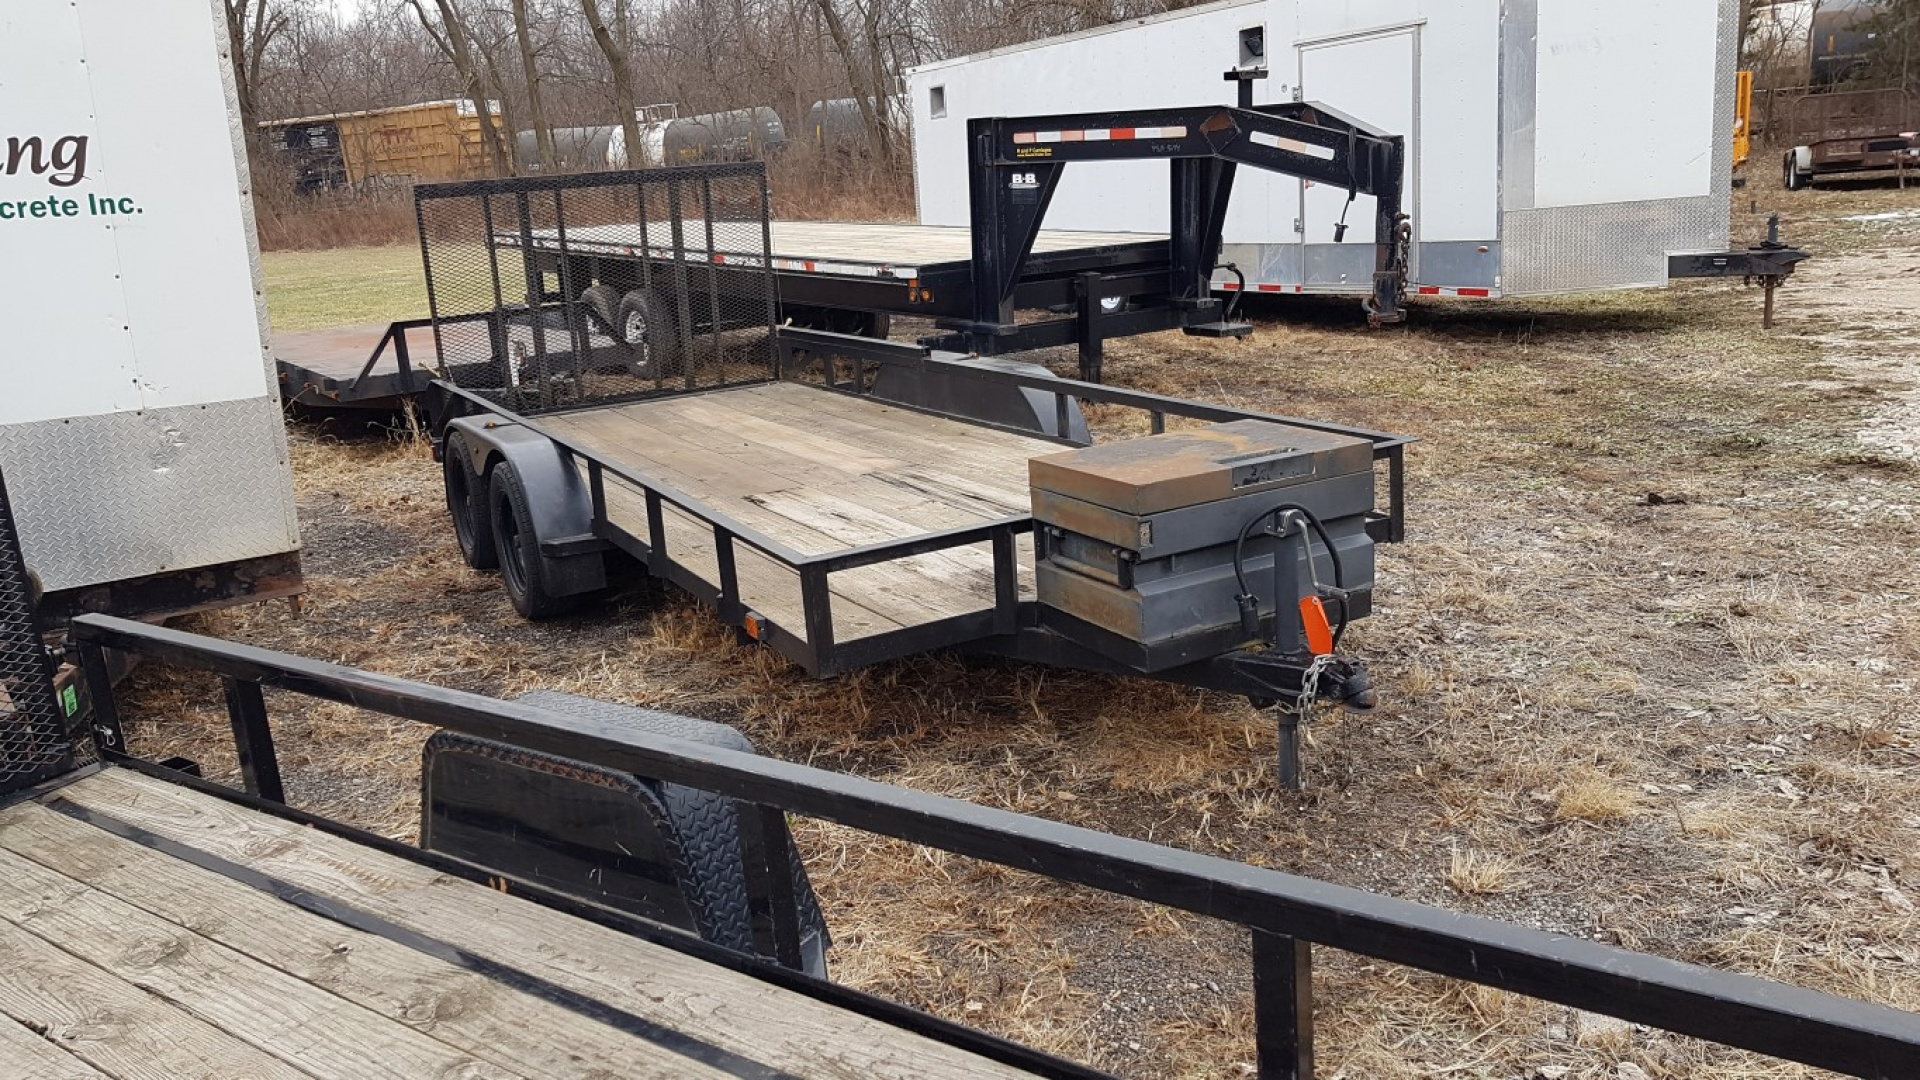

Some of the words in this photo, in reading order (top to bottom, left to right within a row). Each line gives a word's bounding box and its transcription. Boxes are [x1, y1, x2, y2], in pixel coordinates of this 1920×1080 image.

[0, 135, 91, 187] ng
[0, 195, 79, 219] crete
[88, 193, 143, 216] Inc.
